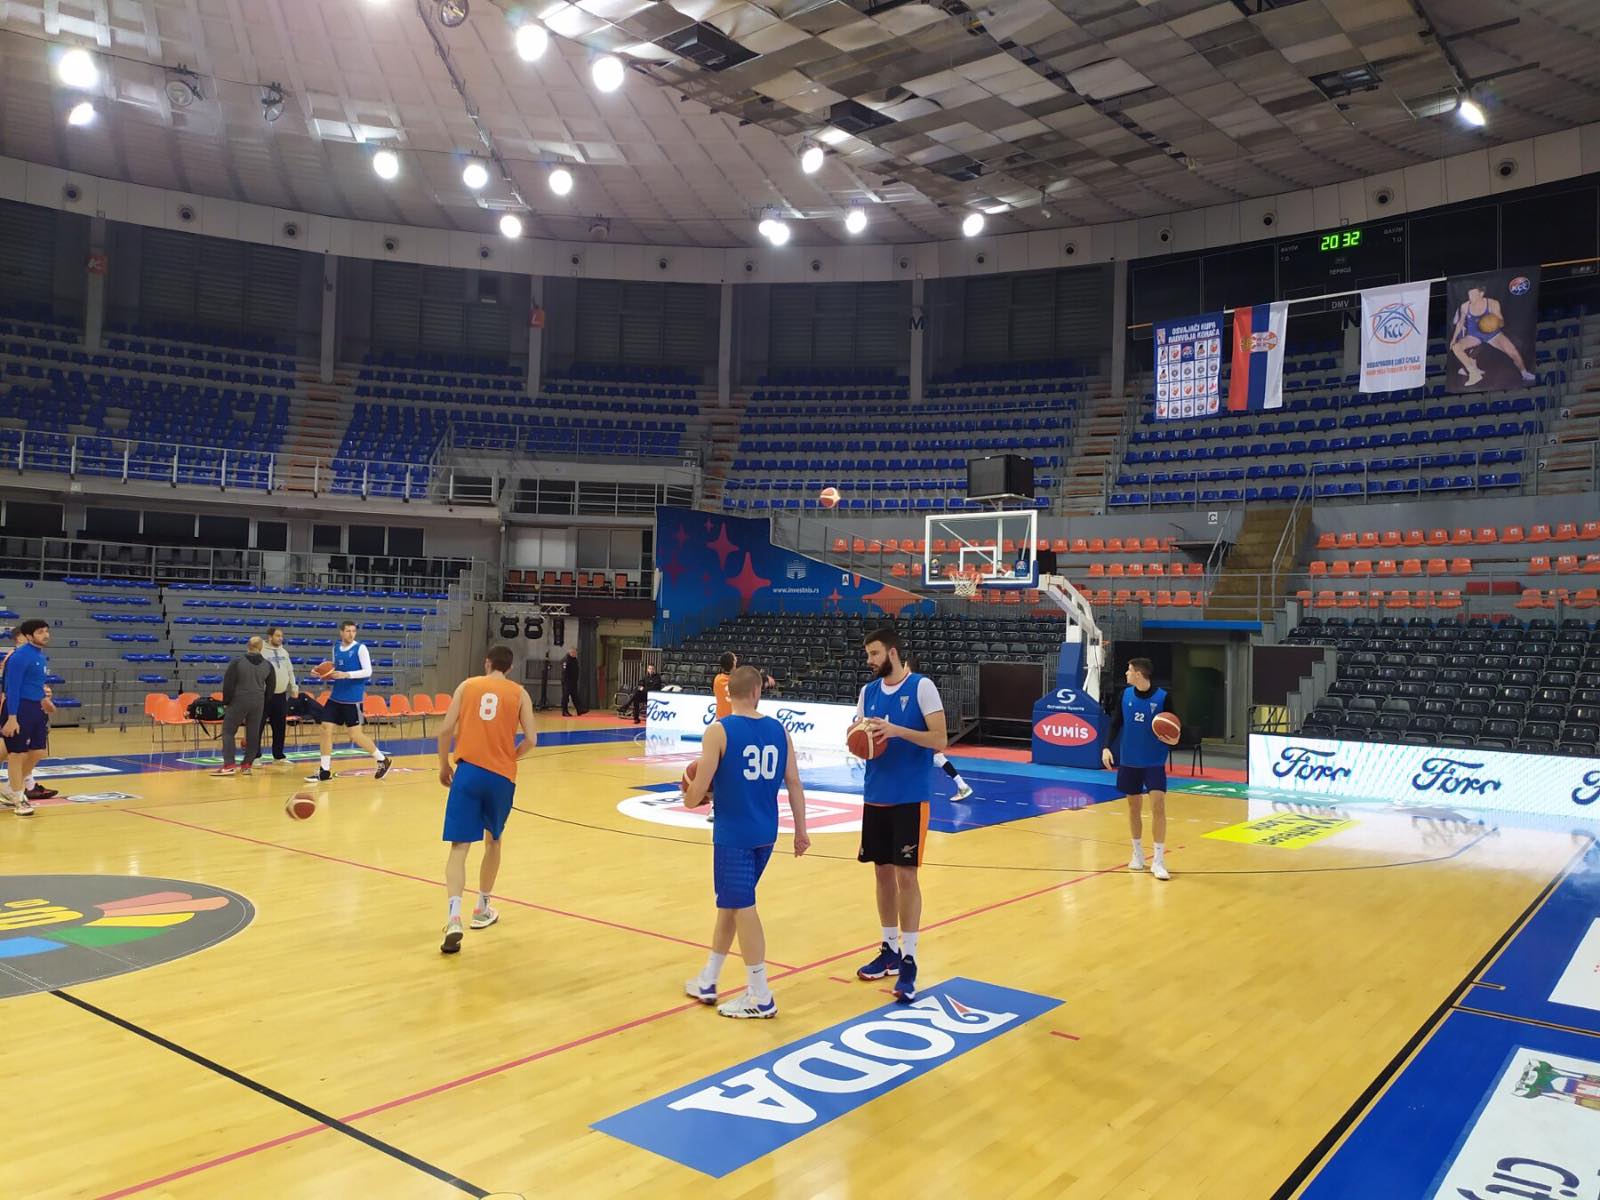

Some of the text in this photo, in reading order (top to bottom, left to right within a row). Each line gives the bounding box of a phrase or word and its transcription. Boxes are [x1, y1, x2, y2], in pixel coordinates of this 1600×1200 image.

[1321, 231, 1360, 250] 20 32
[479, 692, 498, 721] 8
[1134, 712, 1145, 722] 22
[742, 744, 779, 781] 30
[666, 995, 1020, 1125] RODA
